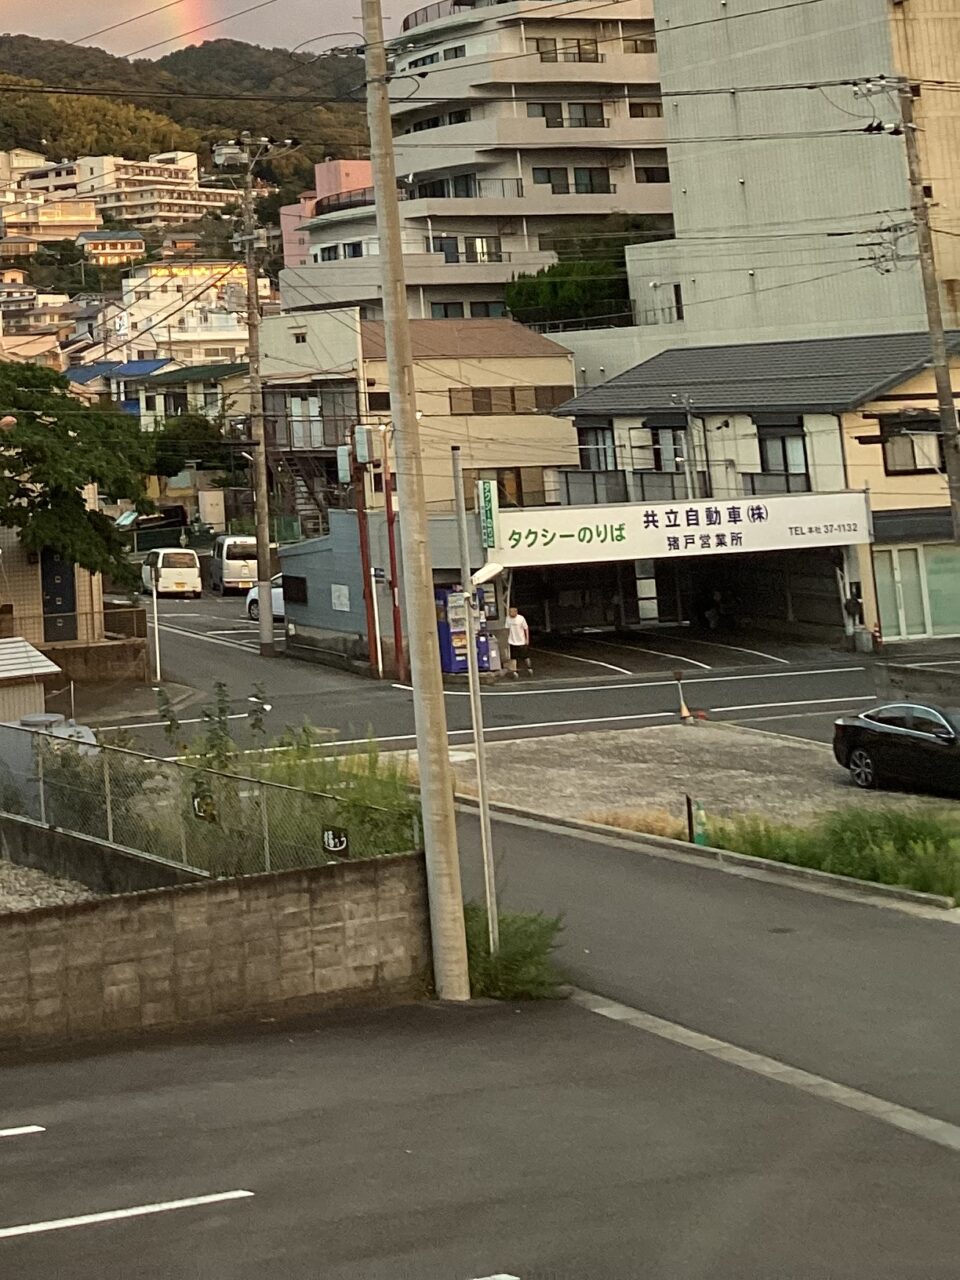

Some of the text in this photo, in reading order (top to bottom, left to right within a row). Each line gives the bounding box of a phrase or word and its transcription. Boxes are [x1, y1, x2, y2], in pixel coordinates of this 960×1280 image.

[508, 523, 626, 549] タクシーのりば
[788, 526, 806, 536] TEL
